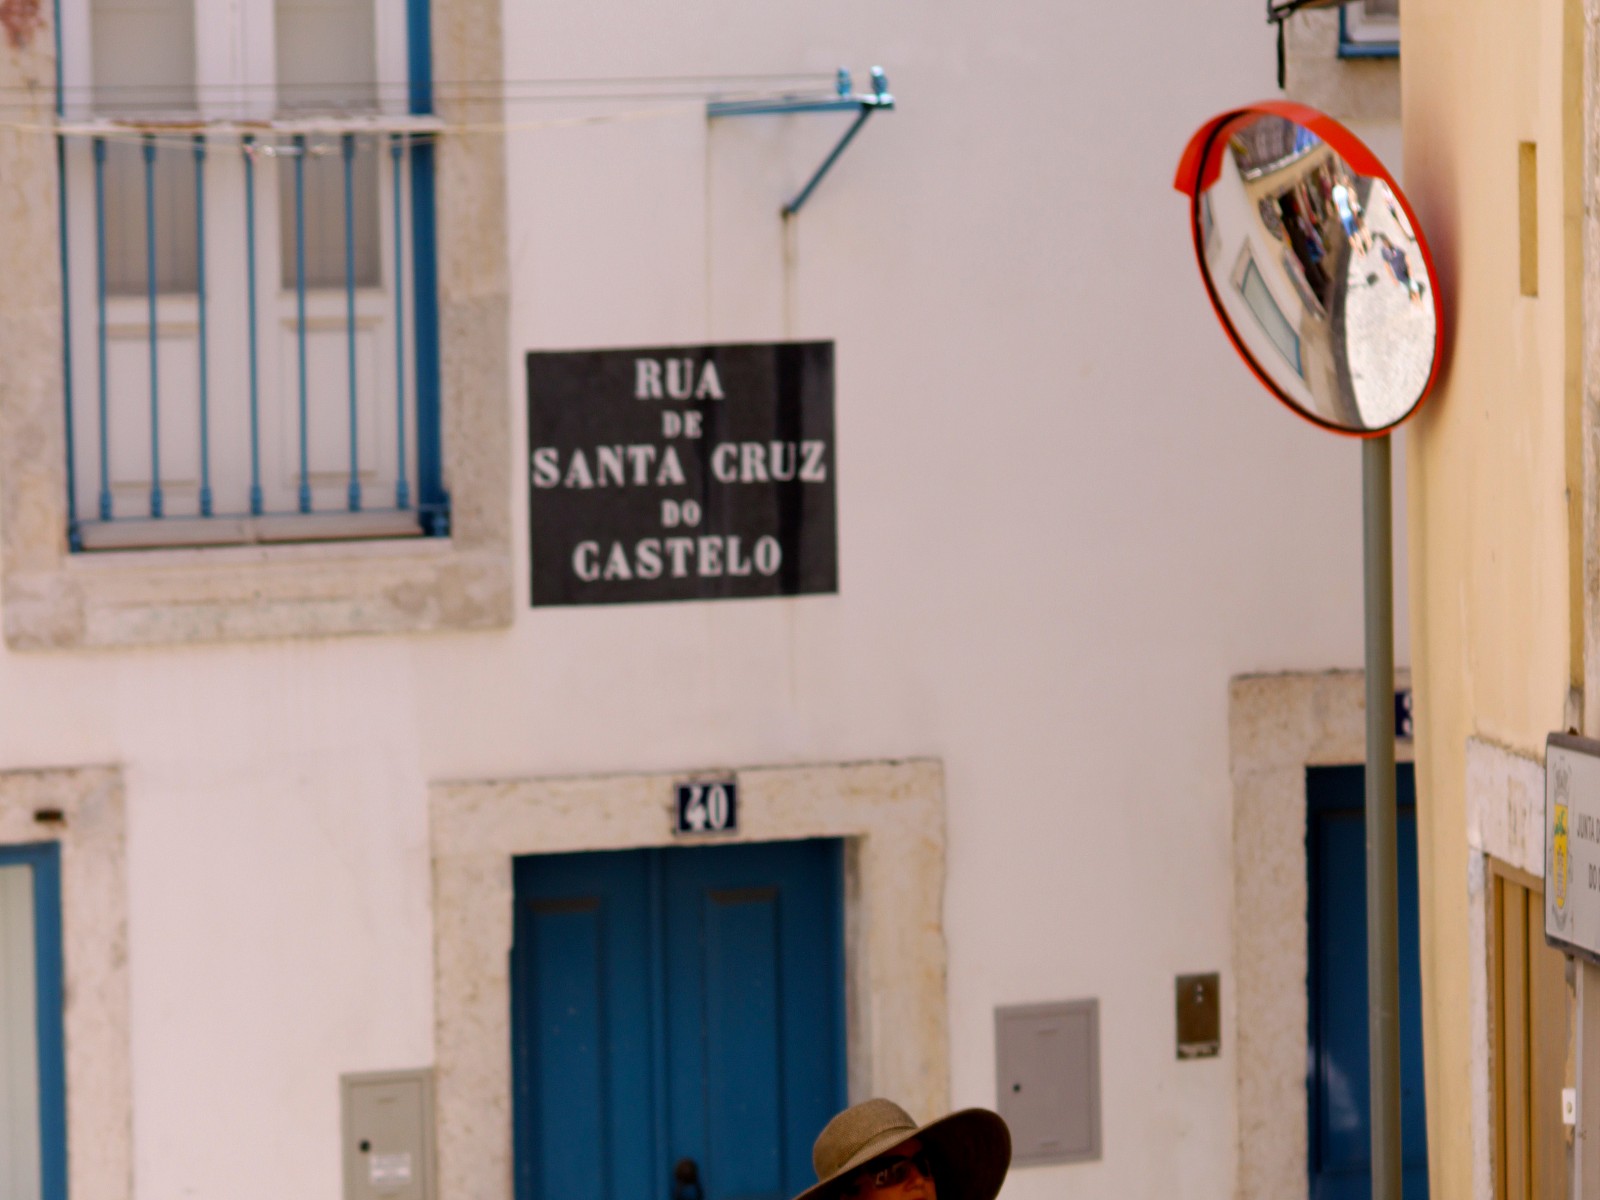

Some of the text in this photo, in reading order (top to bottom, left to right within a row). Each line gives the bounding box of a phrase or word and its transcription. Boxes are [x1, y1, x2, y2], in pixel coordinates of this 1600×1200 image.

[634, 358, 724, 399] RUA
[662, 410, 703, 438] DE
[532, 440, 827, 489] SANTA CRUZ
[661, 499, 702, 528] DO
[572, 535, 782, 582] CASTELO
[685, 784, 729, 832] 40
[1577, 811, 1595, 841] JUNTA
[1588, 863, 1597, 891] DO
